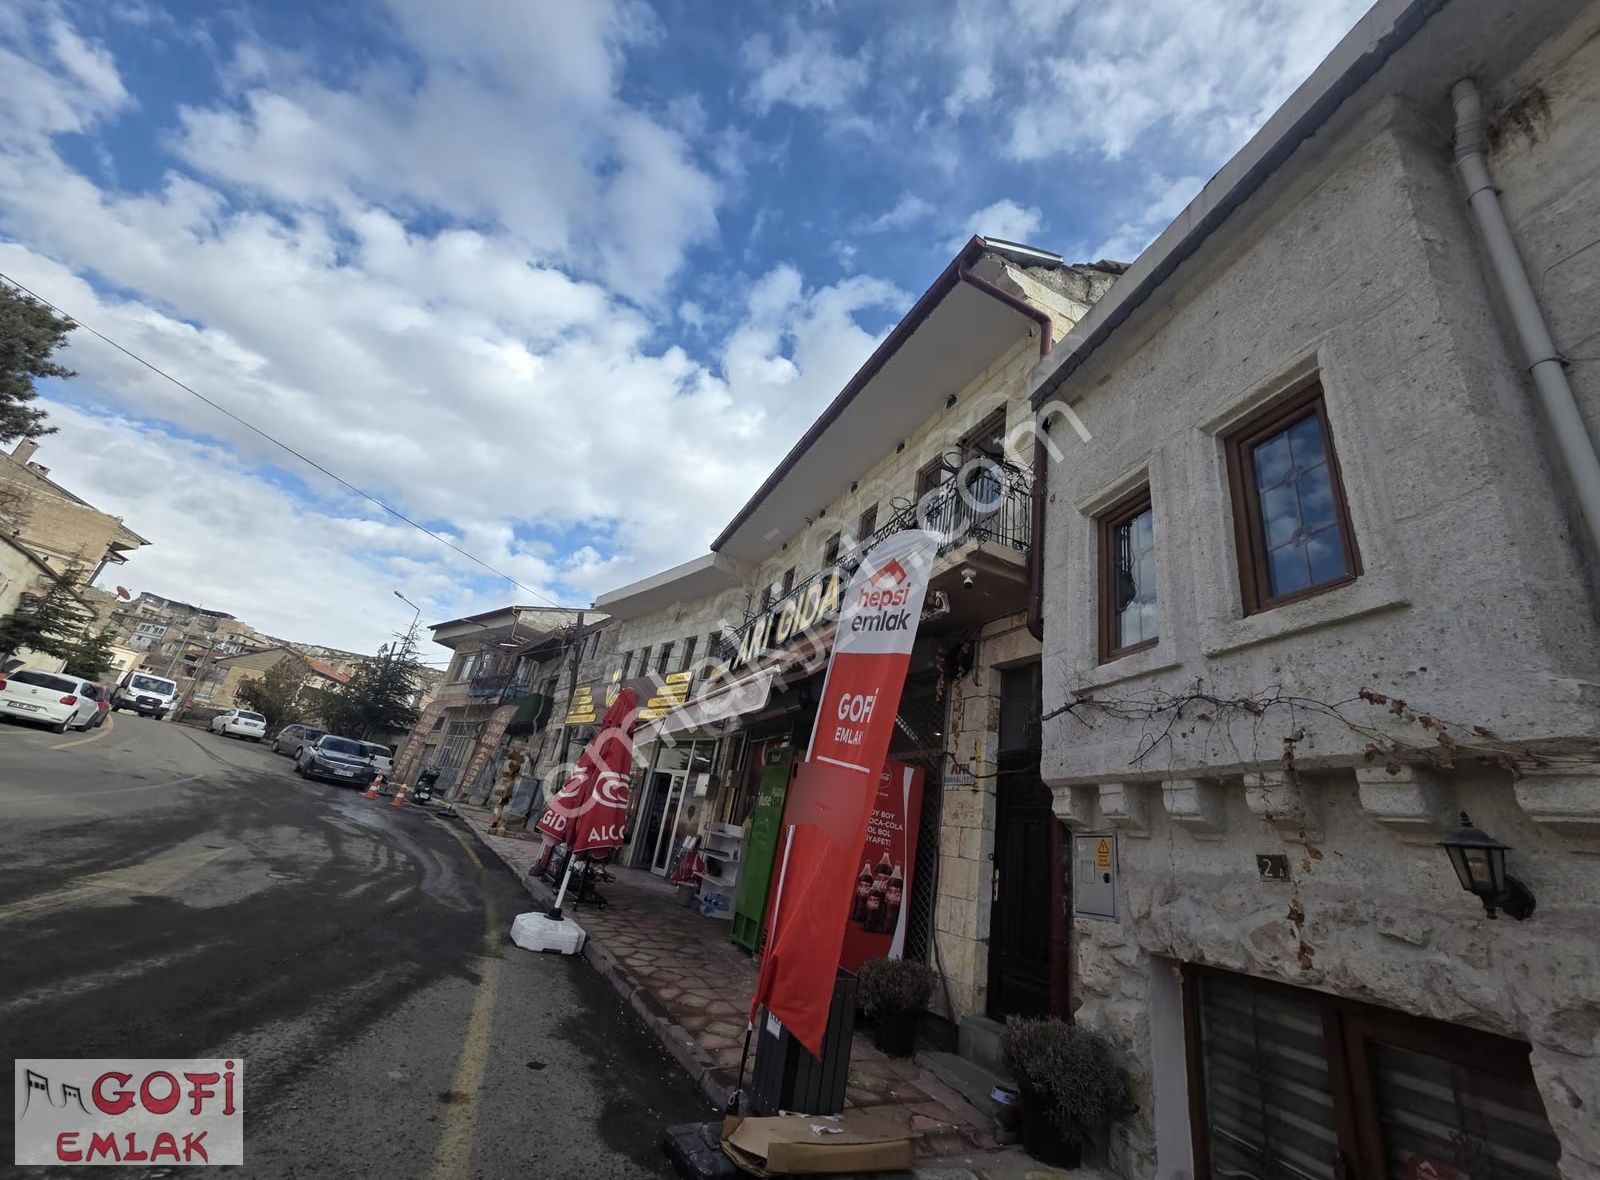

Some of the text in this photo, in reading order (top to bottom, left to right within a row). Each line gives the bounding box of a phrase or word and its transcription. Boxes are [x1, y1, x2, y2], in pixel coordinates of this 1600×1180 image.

[857, 581, 913, 611] hepsi
[851, 606, 912, 632] emlak
[837, 687, 879, 724] GOFİ
[834, 727, 864, 746] EMLAK
[869, 817, 904, 831] OCA-COLA
[881, 810, 896, 820] BOY
[877, 828, 892, 838] BOL
